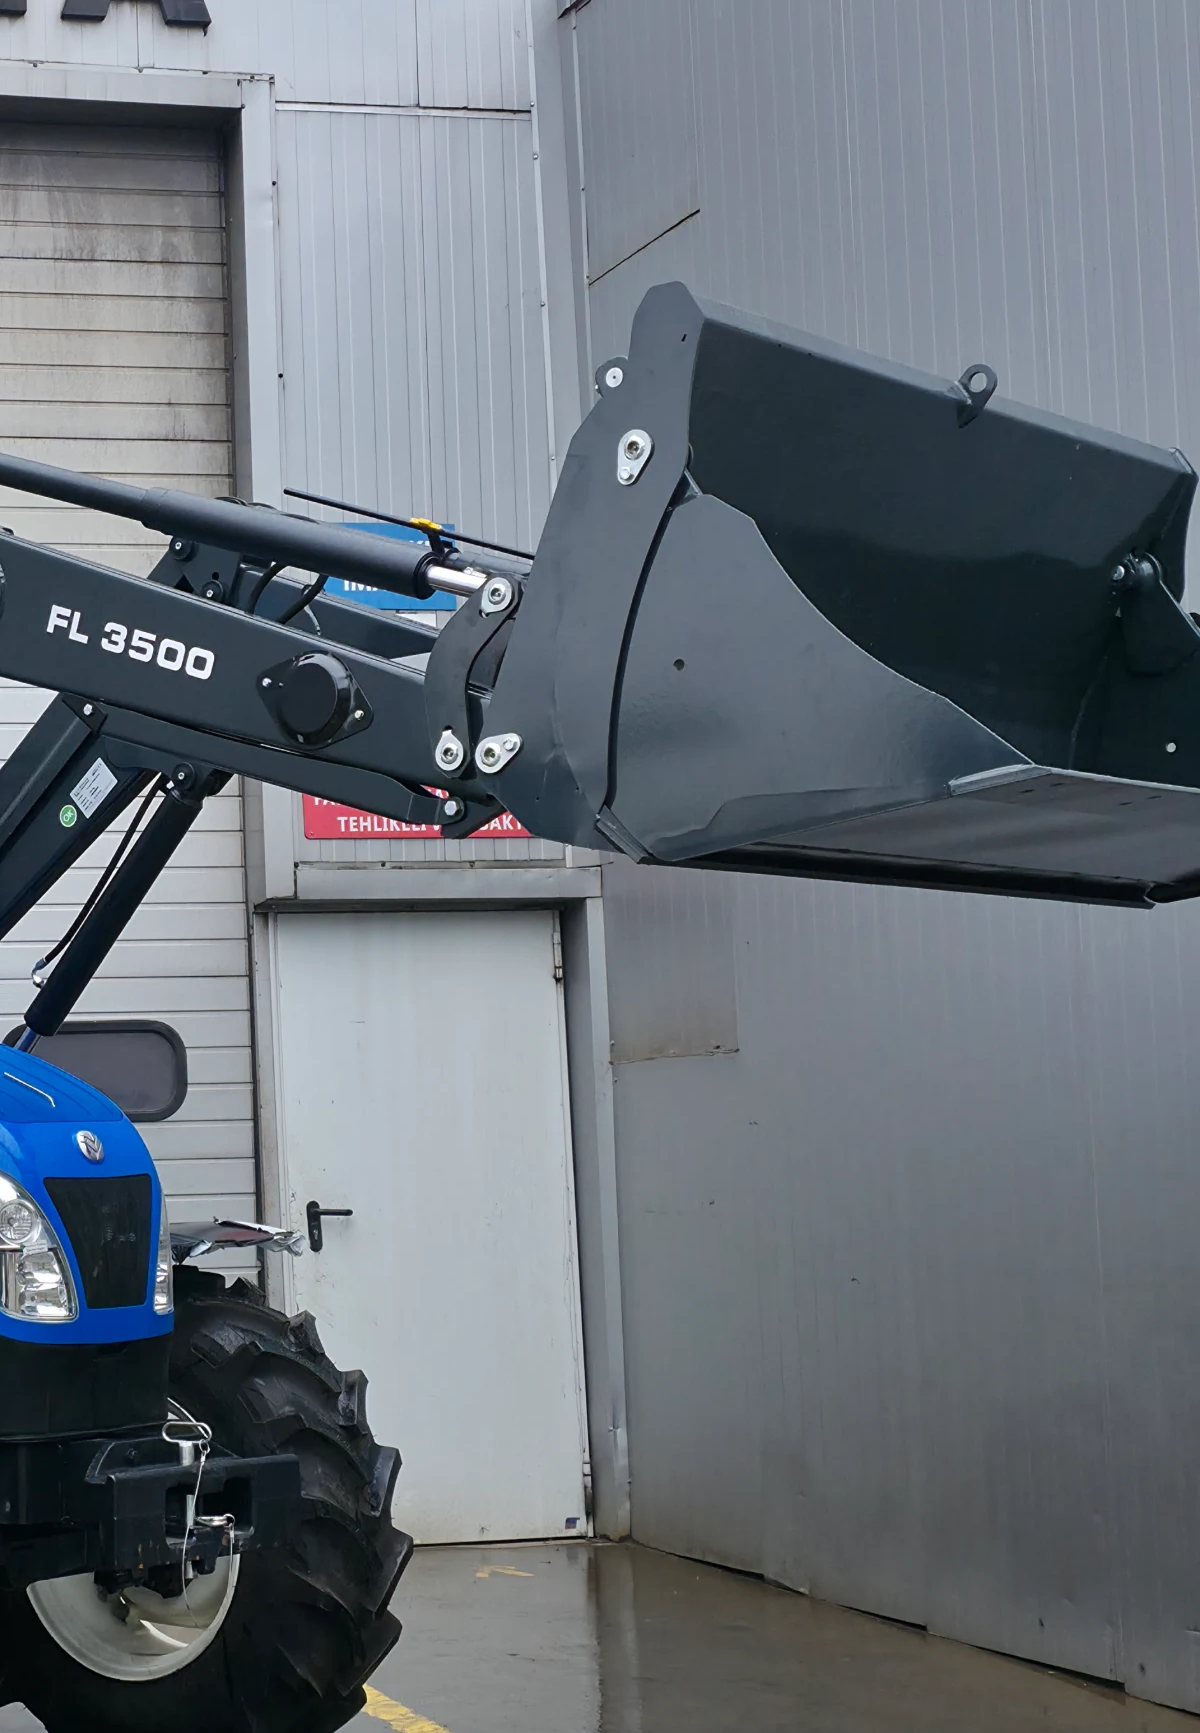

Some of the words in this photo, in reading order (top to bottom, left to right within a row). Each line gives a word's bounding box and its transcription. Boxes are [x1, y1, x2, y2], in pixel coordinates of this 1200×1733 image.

[46, 604, 89, 644] FL
[101, 622, 215, 680] 3500
[63, 808, 74, 822] OK
